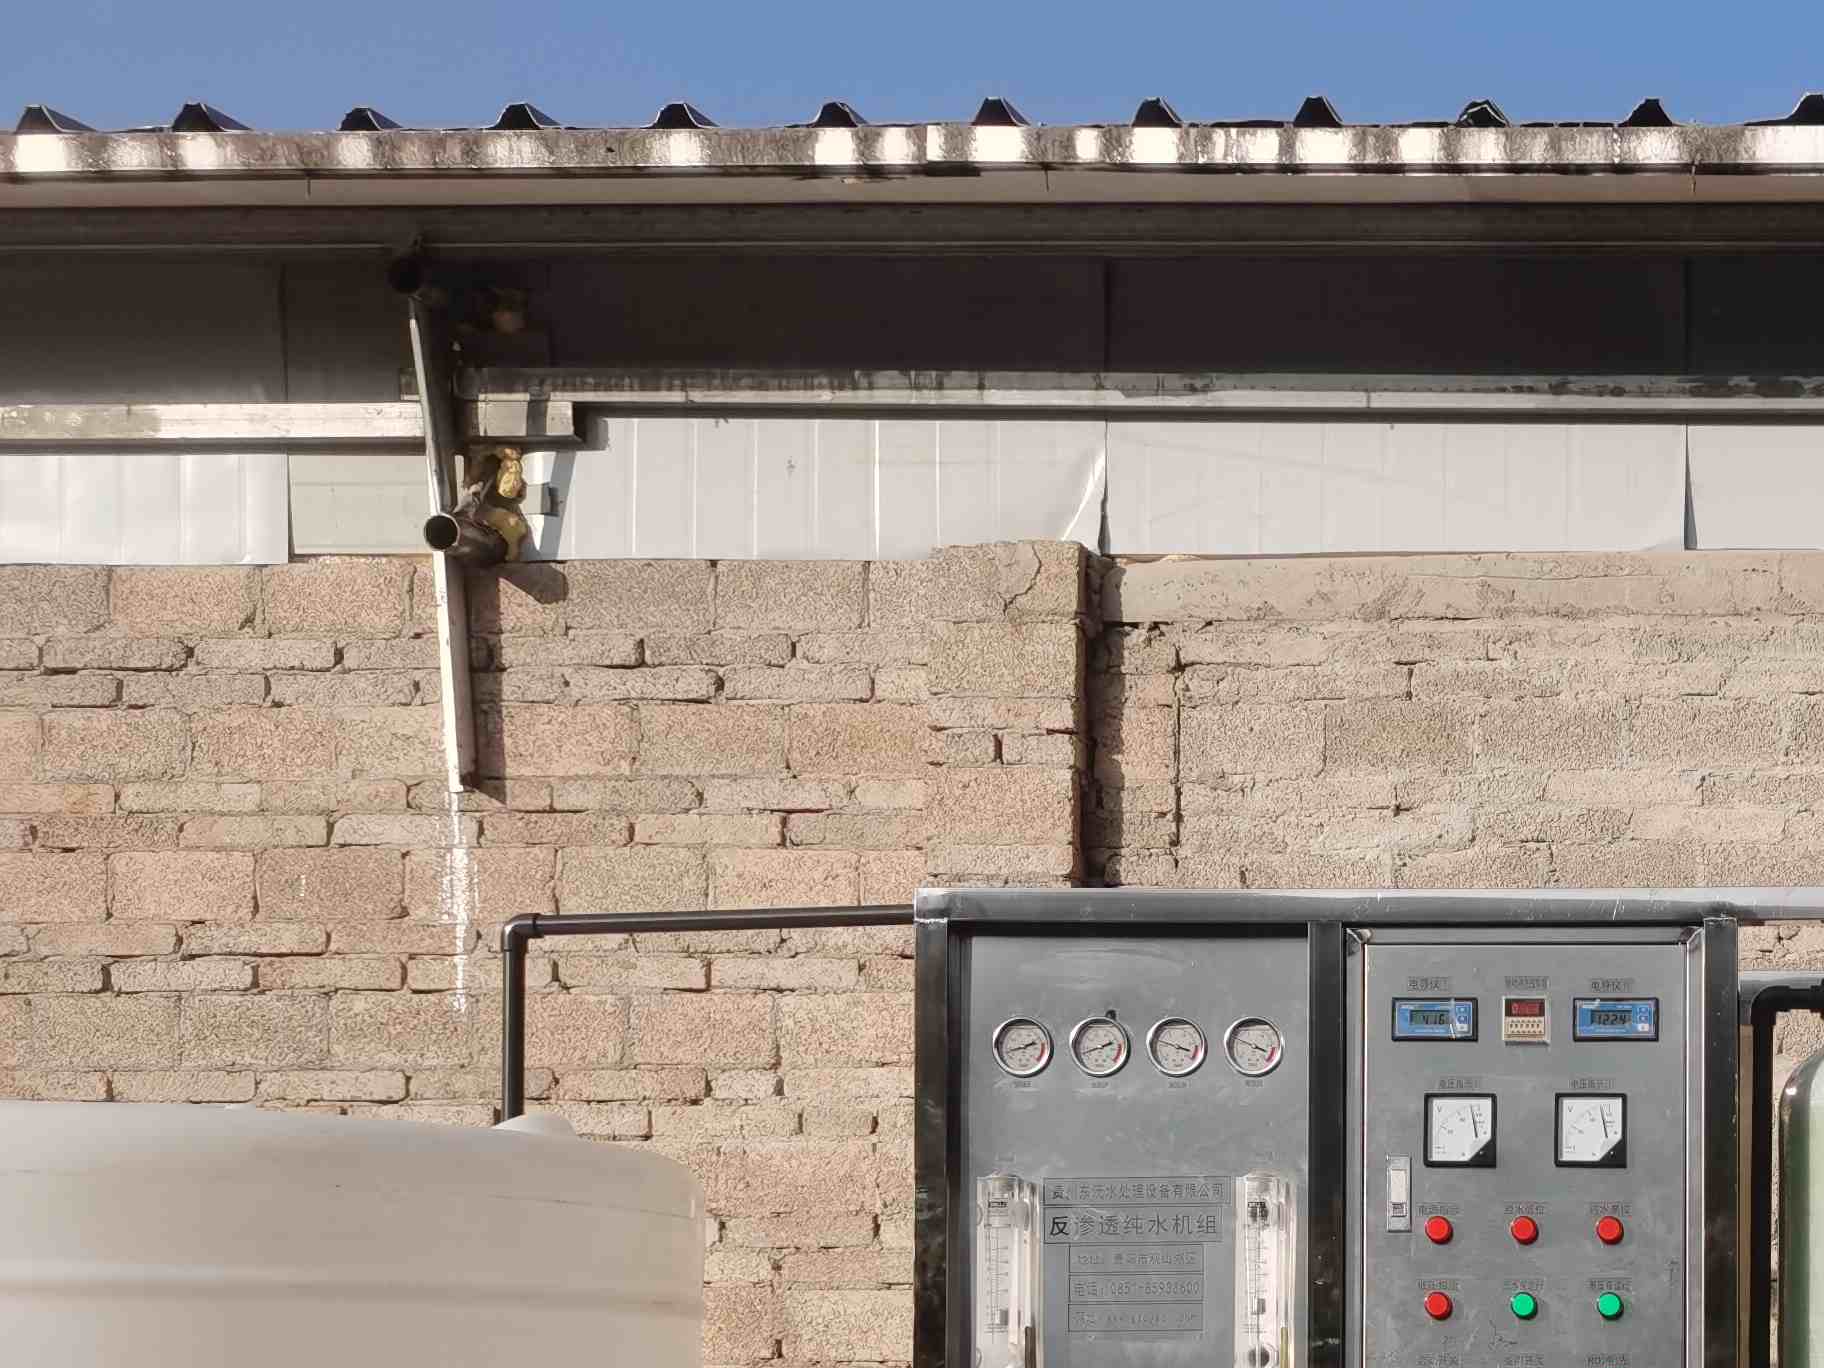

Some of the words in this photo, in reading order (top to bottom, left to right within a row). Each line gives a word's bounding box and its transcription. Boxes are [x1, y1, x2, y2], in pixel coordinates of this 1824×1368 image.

[1049, 1214, 1217, 1236] 反渗透纯水机组
